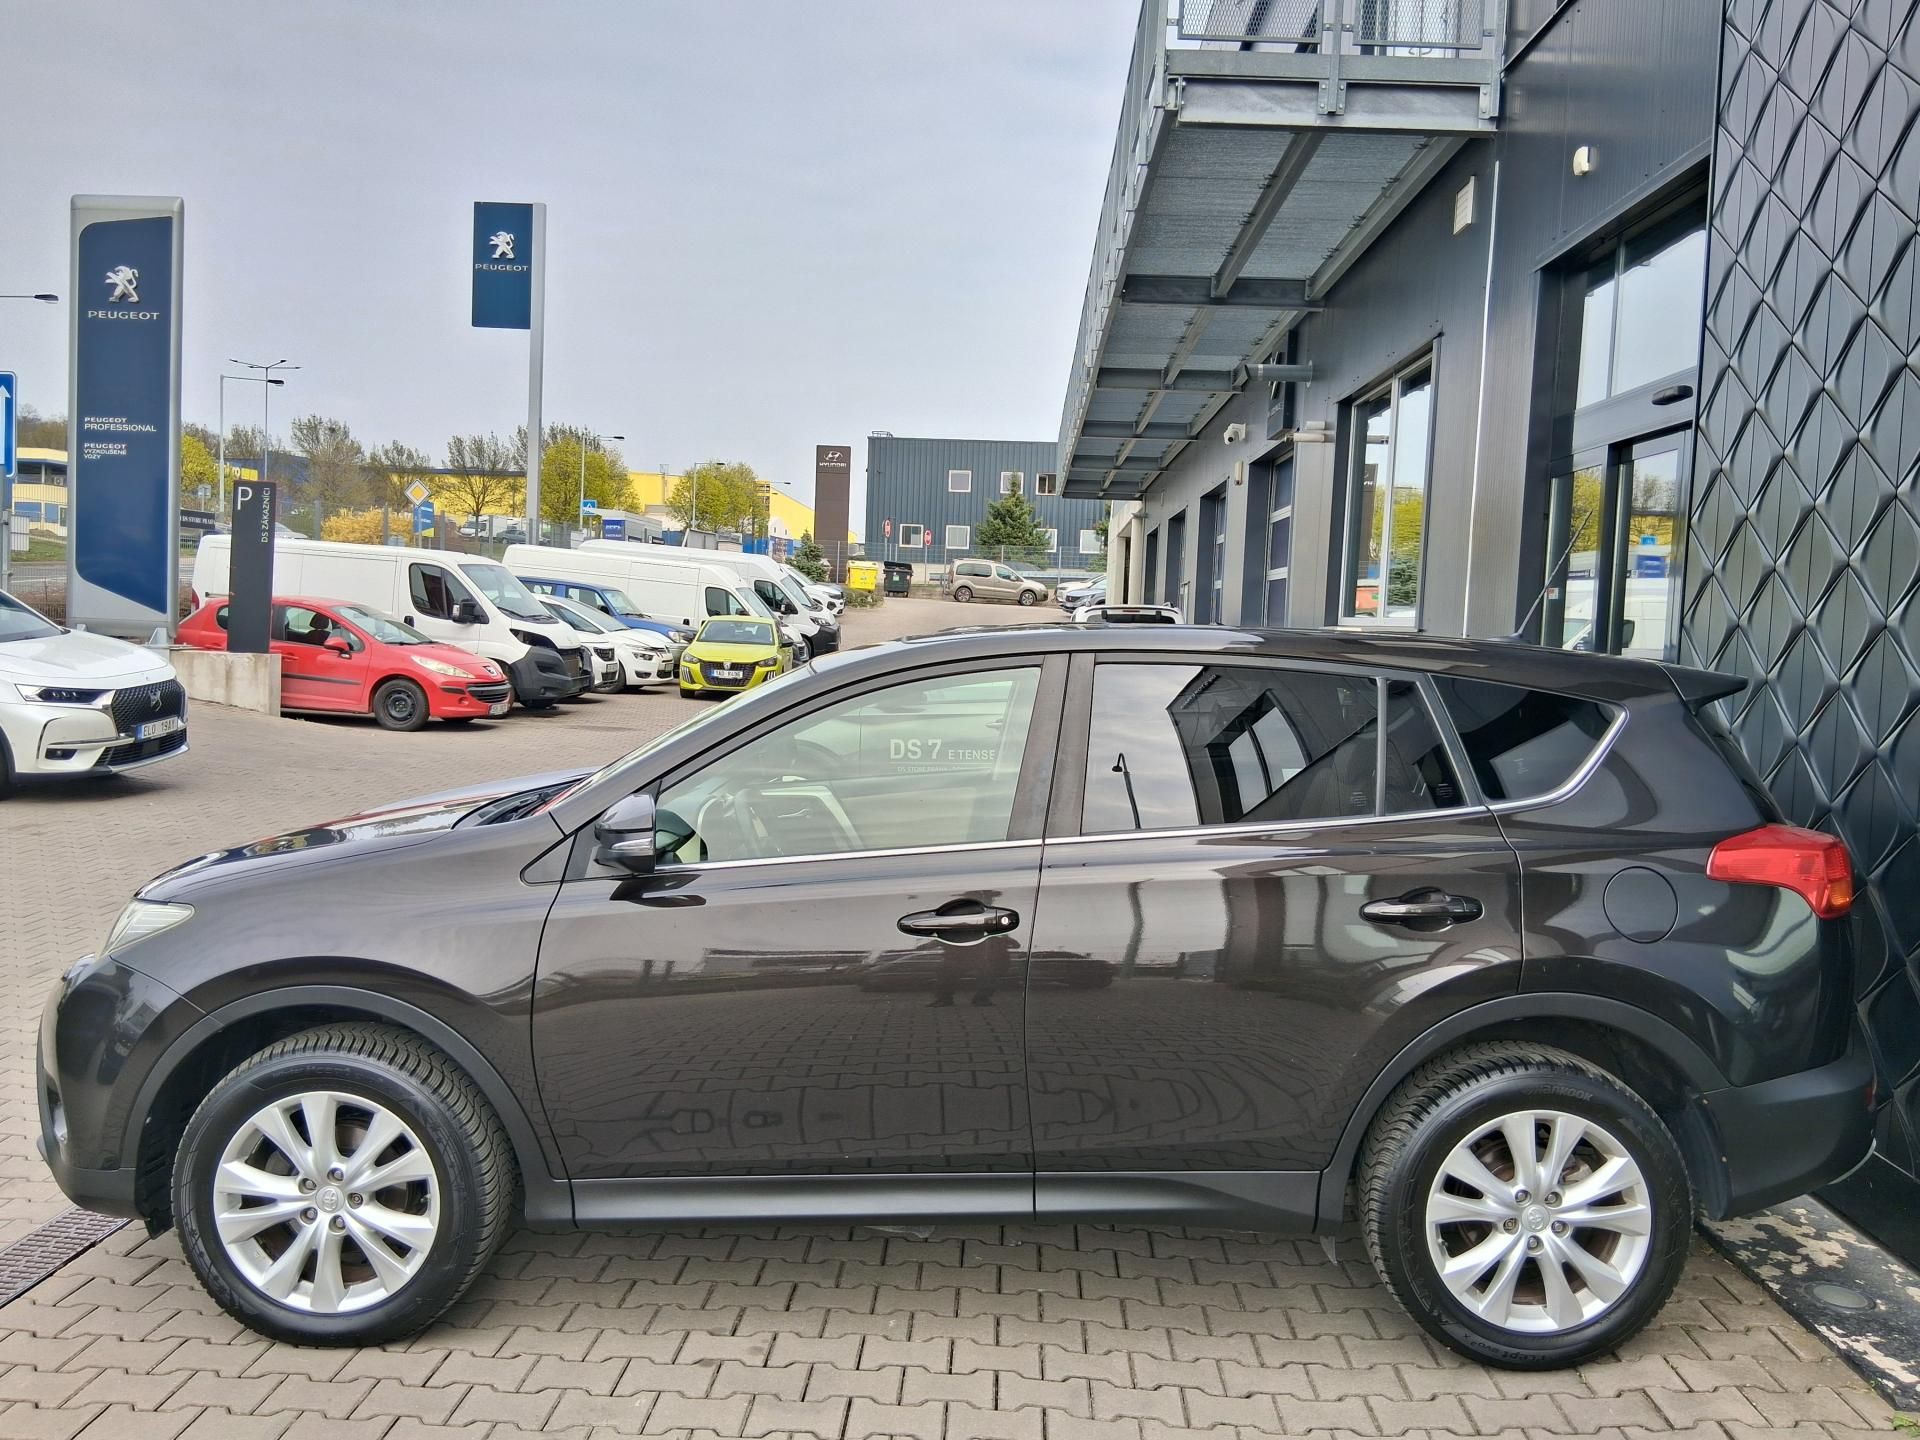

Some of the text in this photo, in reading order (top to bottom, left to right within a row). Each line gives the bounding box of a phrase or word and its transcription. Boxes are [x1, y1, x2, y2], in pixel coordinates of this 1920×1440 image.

[475, 263, 529, 272] PEUGEOT
[87, 310, 160, 320] PEUGEOT
[84, 416, 128, 424] PEUGEOT
[84, 423, 157, 432] PROFESSIONAL
[237, 486, 253, 510] P
[261, 531, 269, 543] DS
[890, 738, 996, 761] DS 7 E TENSE
